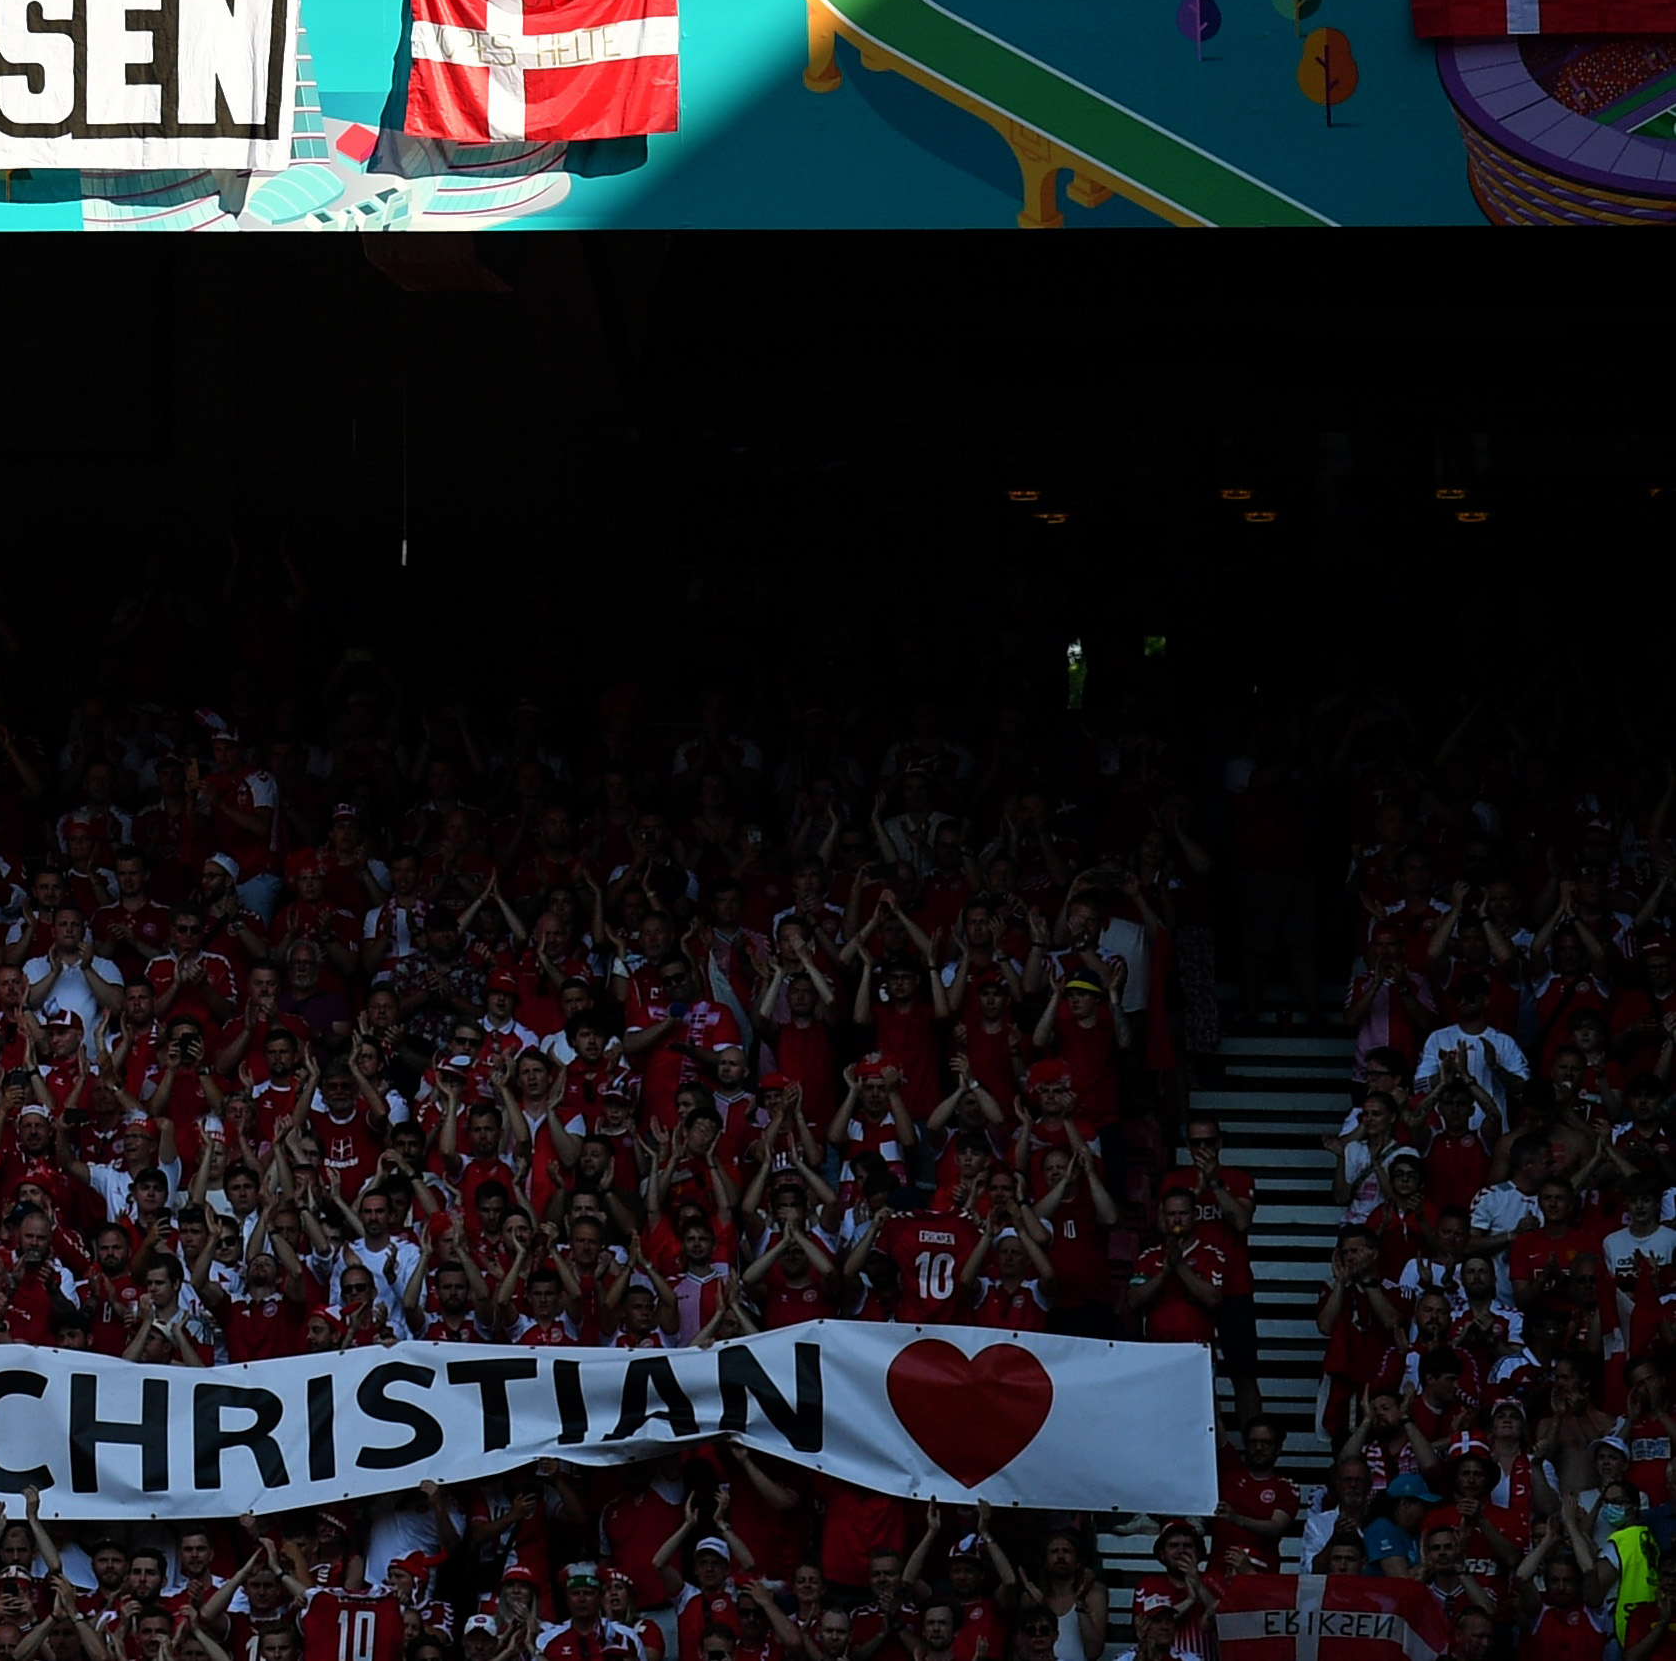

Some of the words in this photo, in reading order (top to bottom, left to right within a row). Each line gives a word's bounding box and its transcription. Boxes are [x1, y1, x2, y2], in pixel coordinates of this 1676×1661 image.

[1064, 1220, 1077, 1239] 10
[915, 1251, 956, 1299] 10
[338, 1610, 376, 1660] 10
